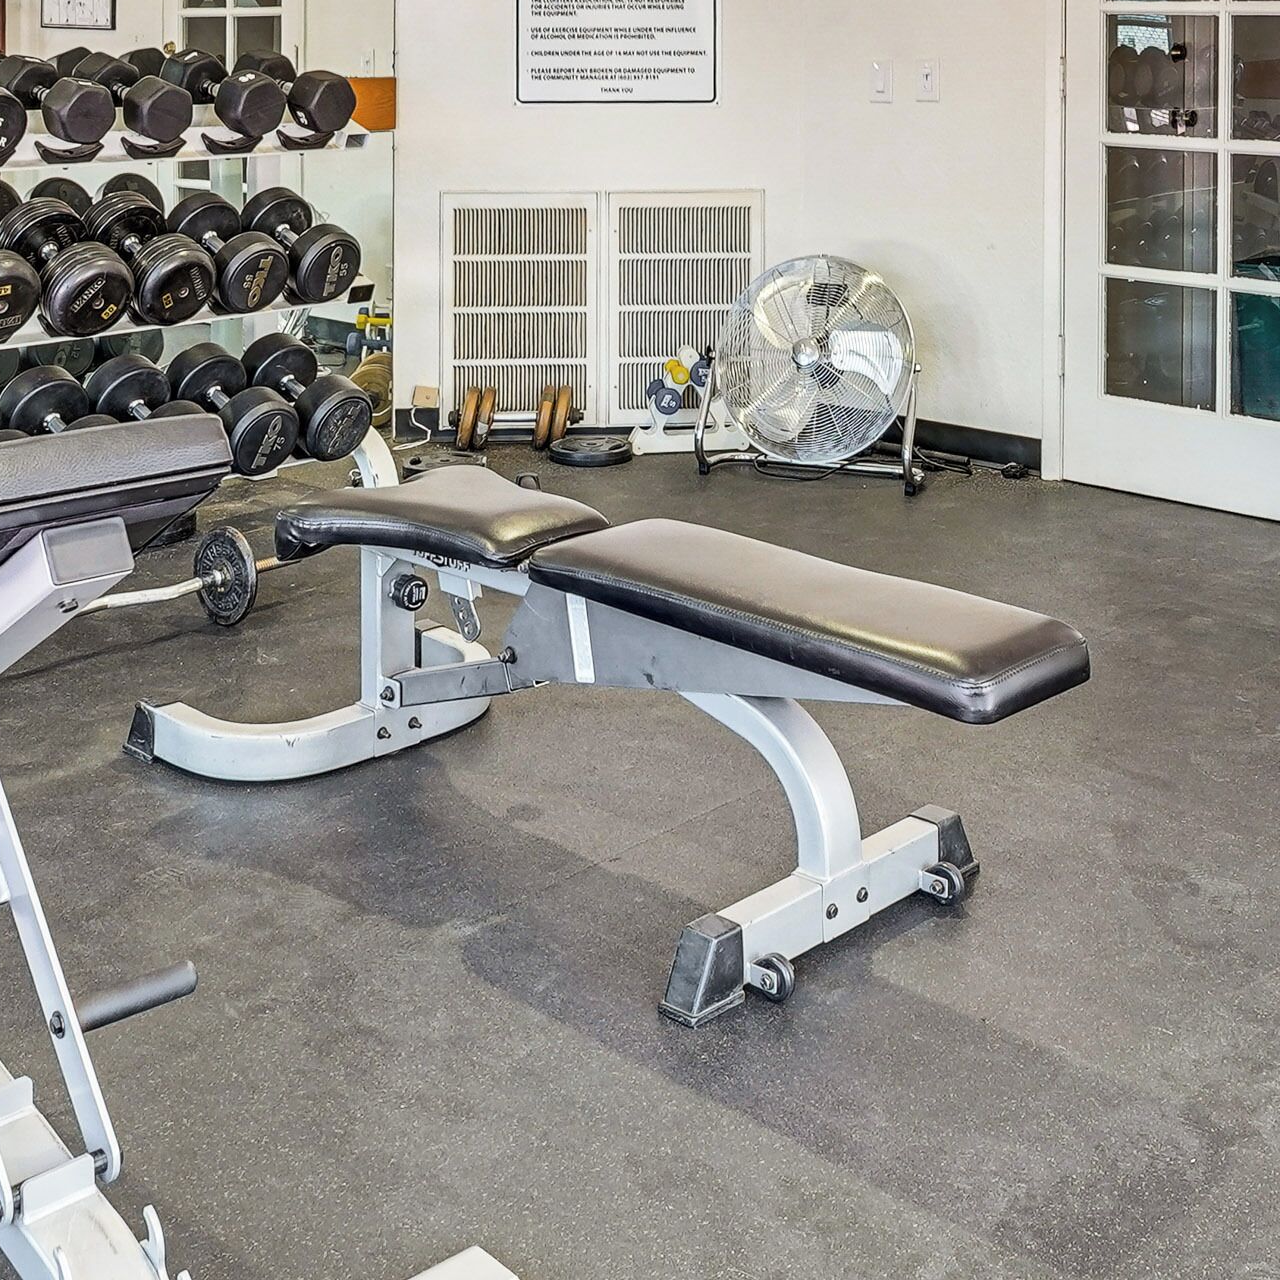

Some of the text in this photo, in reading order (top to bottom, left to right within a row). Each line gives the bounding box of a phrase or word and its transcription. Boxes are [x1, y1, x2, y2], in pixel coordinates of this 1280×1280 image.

[243, 274, 254, 289] 55
[322, 246, 343, 297] TKO
[340, 262, 350, 276] 55
[70, 277, 106, 312] IVANKO
[248, 256, 273, 308] TKO
[101, 303, 117, 319] 50
[251, 415, 282, 469] TKO
[273, 437, 286, 451] 75
